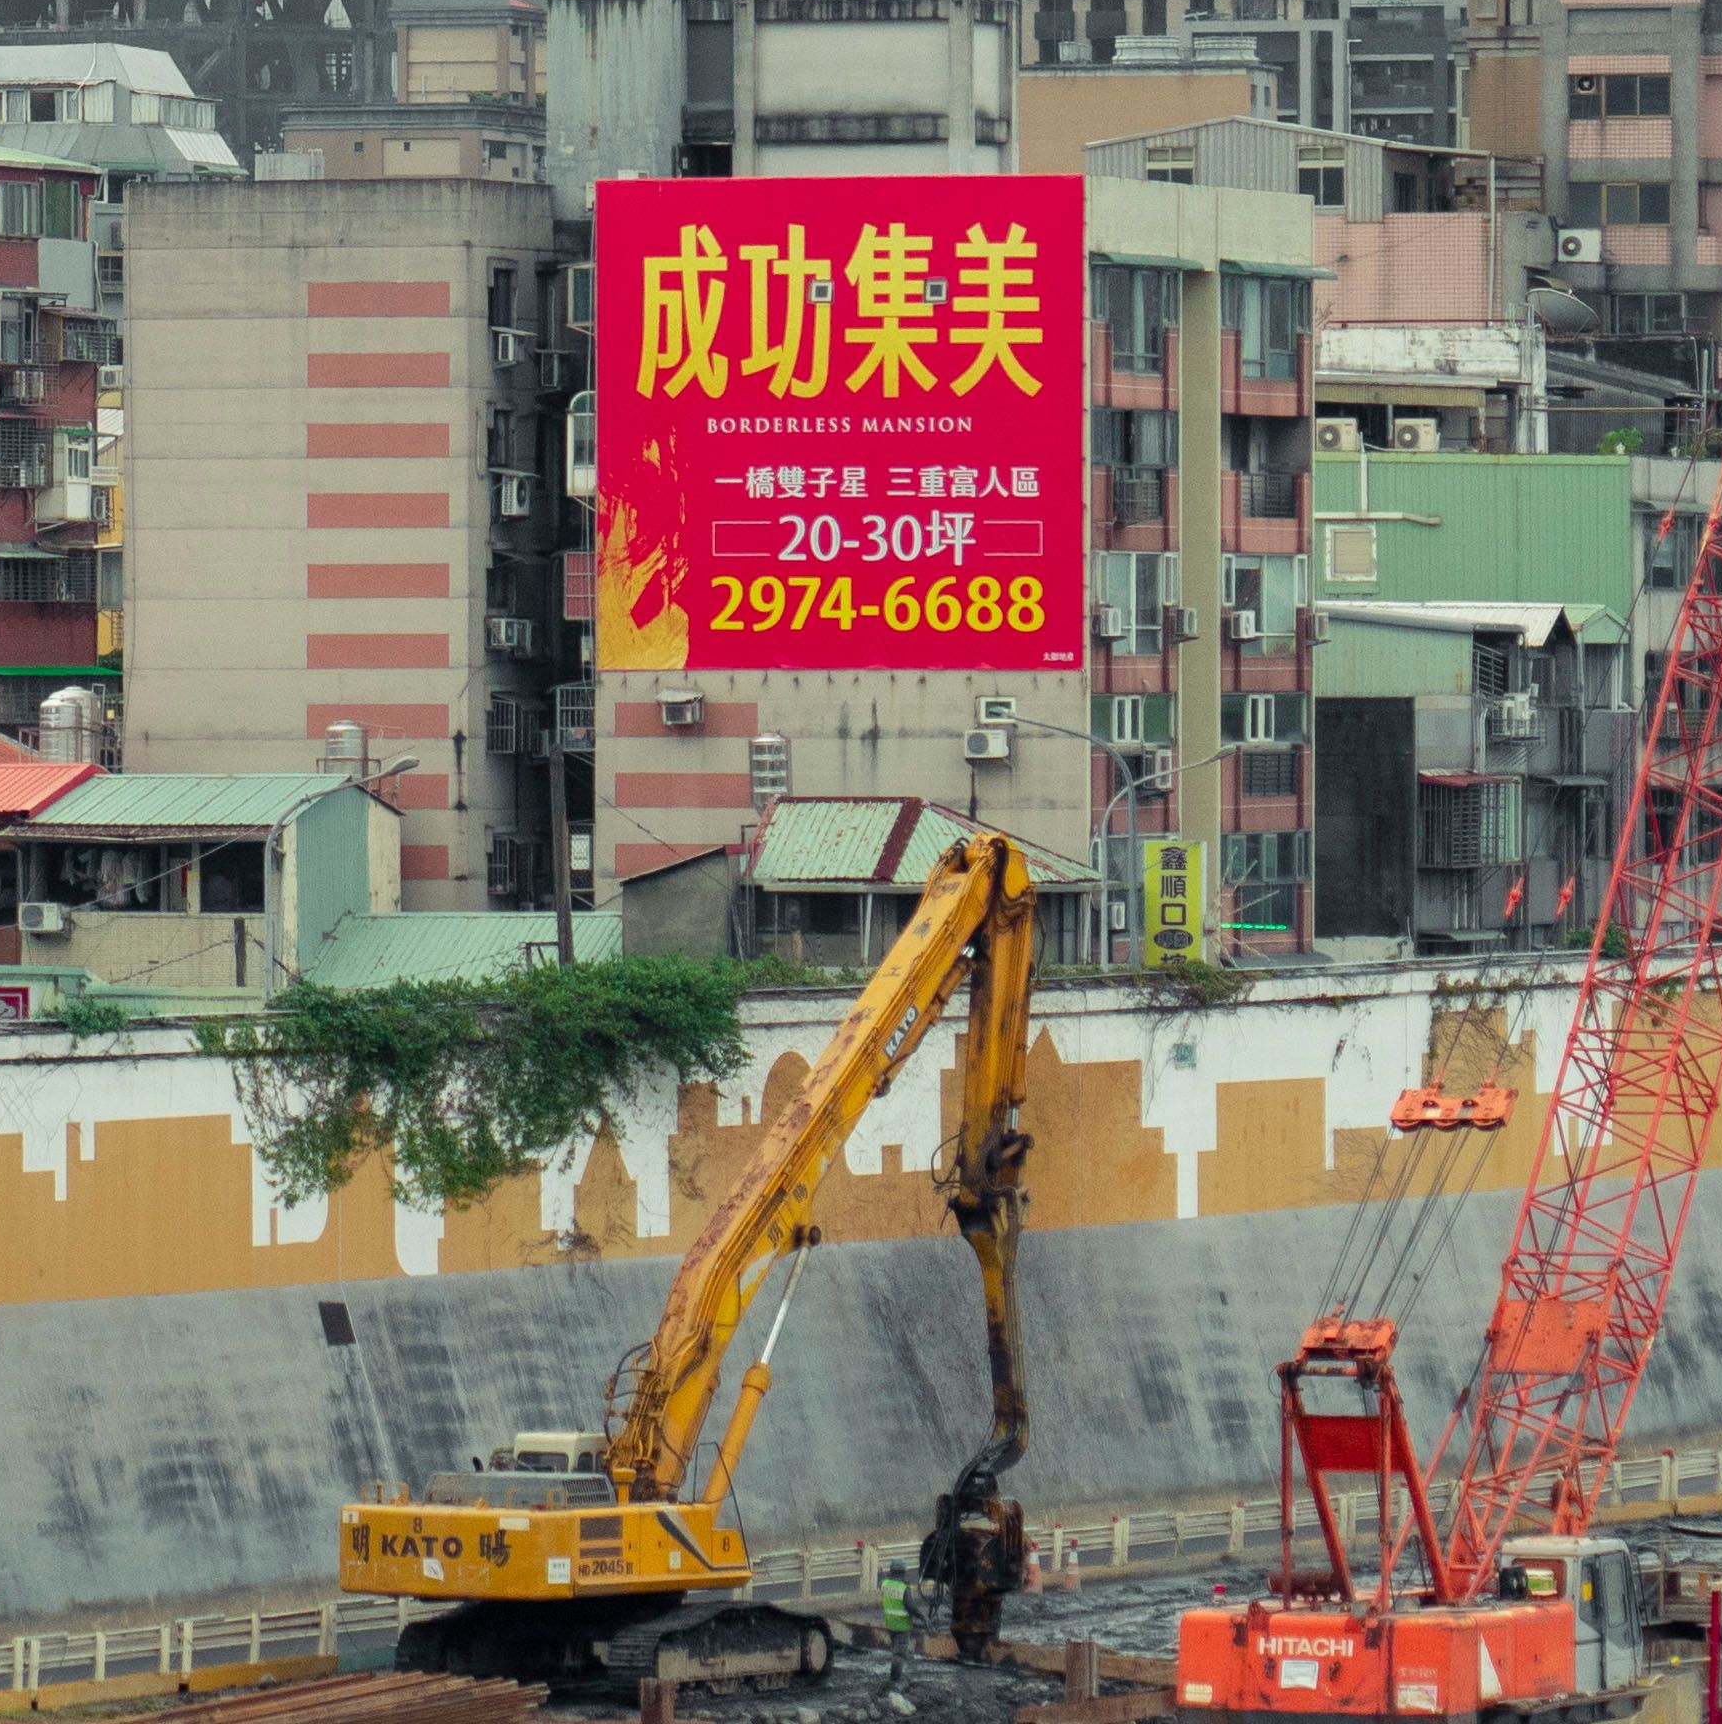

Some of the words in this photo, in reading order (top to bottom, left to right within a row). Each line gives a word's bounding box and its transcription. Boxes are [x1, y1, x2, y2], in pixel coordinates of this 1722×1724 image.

[636, 222, 1044, 400] 成功集美
[707, 417, 851, 434] BORDERLESS
[862, 417, 973, 434] MANSION
[715, 467, 869, 499] 一橋雙子星
[886, 467, 1040, 499] 三重富人區
[778, 511, 976, 566] 20-30坪
[709, 576, 1046, 632] 2974-6688
[381, 1534, 464, 1559] KATO
[1258, 1636, 1354, 1658] HITACHI
